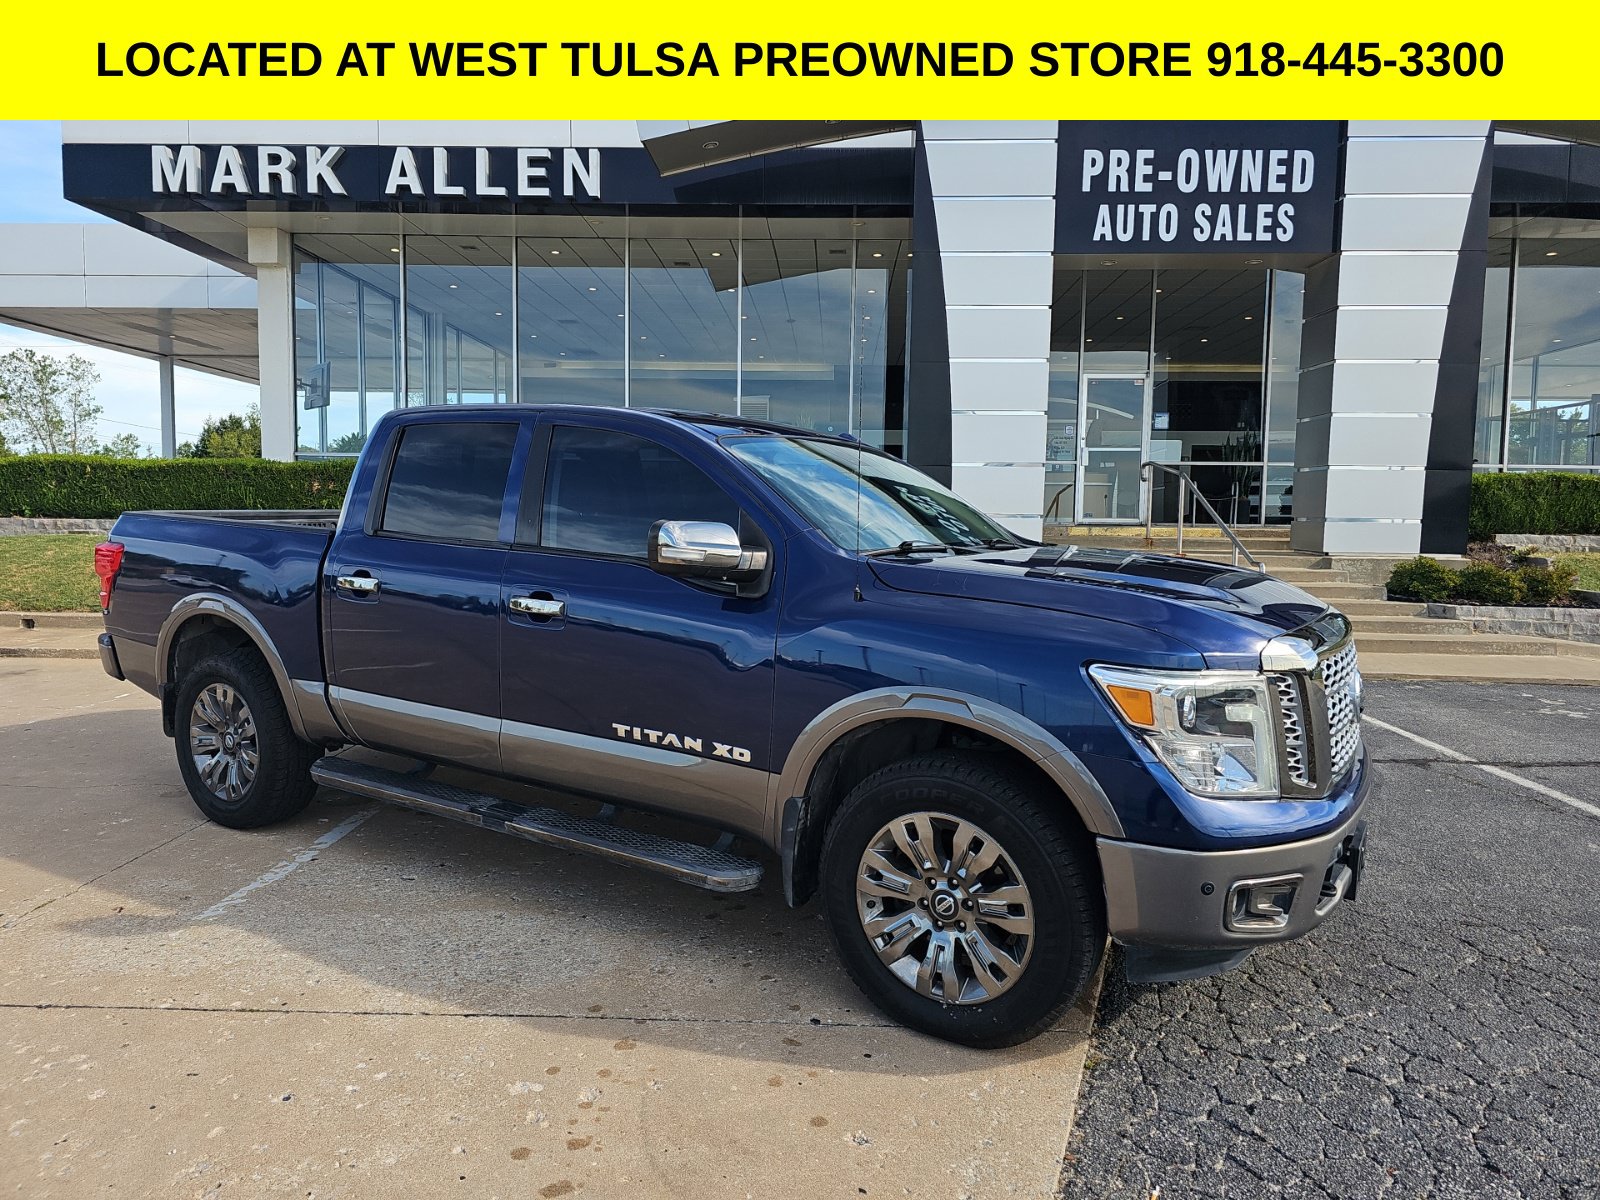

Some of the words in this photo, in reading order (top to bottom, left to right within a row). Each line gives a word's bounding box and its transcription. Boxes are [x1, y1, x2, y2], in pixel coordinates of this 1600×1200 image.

[151, 145, 348, 196] MARK
[384, 146, 601, 199] ALLEN
[1081, 148, 1315, 194] PRE-OWNED
[1092, 202, 1179, 242] AUTO
[1193, 202, 1295, 242] SALES
[611, 722, 703, 753] TITAN
[711, 741, 752, 763] XD
